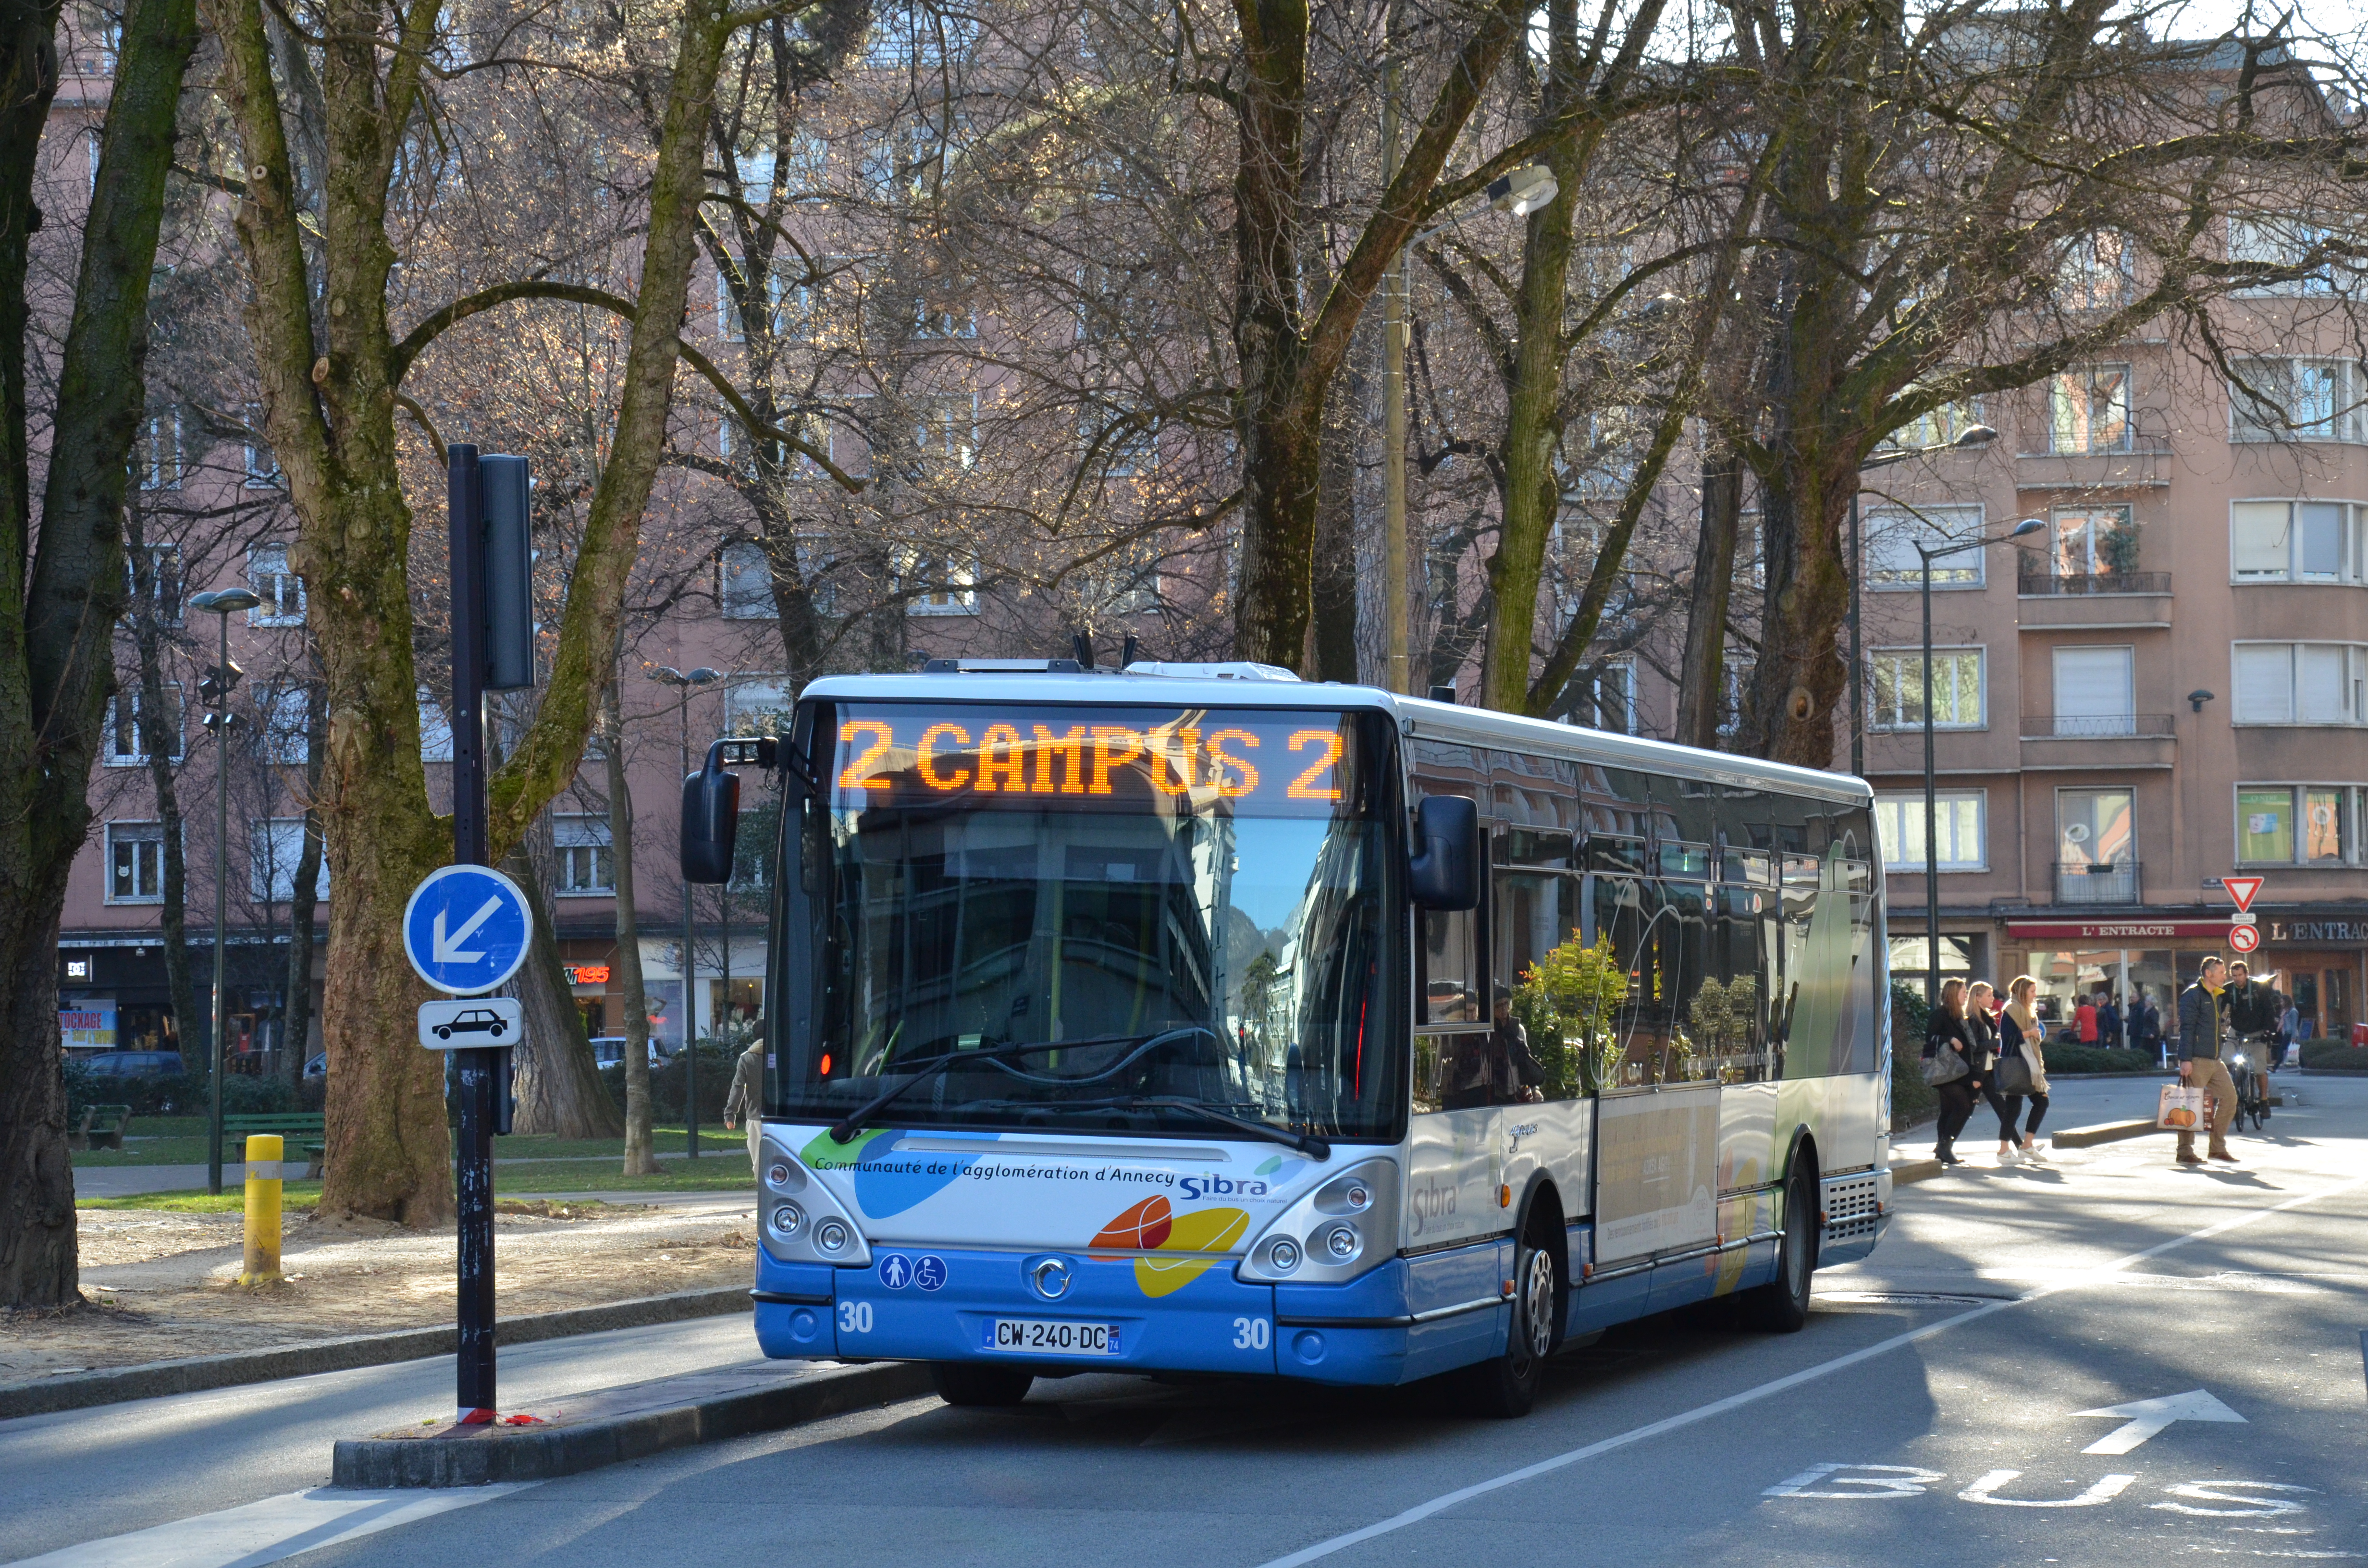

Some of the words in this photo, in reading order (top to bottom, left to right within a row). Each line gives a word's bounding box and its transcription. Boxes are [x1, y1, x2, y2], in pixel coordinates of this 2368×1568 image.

[839, 721, 892, 789] 2
[917, 723, 1260, 797] CAMPUS
[1287, 730, 1343, 799] 2
[2099, 926, 2174, 935] ENTRACTE
[574, 967, 610, 983] 195
[815, 1157, 922, 1174] Communauté
[927, 1161, 946, 1175] de
[952, 1160, 1089, 1180] l'agglomération
[1095, 1165, 1175, 1187] d'Annecy
[1179, 1171, 1267, 1200] Sibra
[839, 1301, 873, 1333] 30
[998, 1322, 1106, 1349] CW-240-DC
[1110, 1340, 1119, 1351] 74
[1233, 1318, 1269, 1349] 30
[1761, 1462, 2326, 1518] BUS
